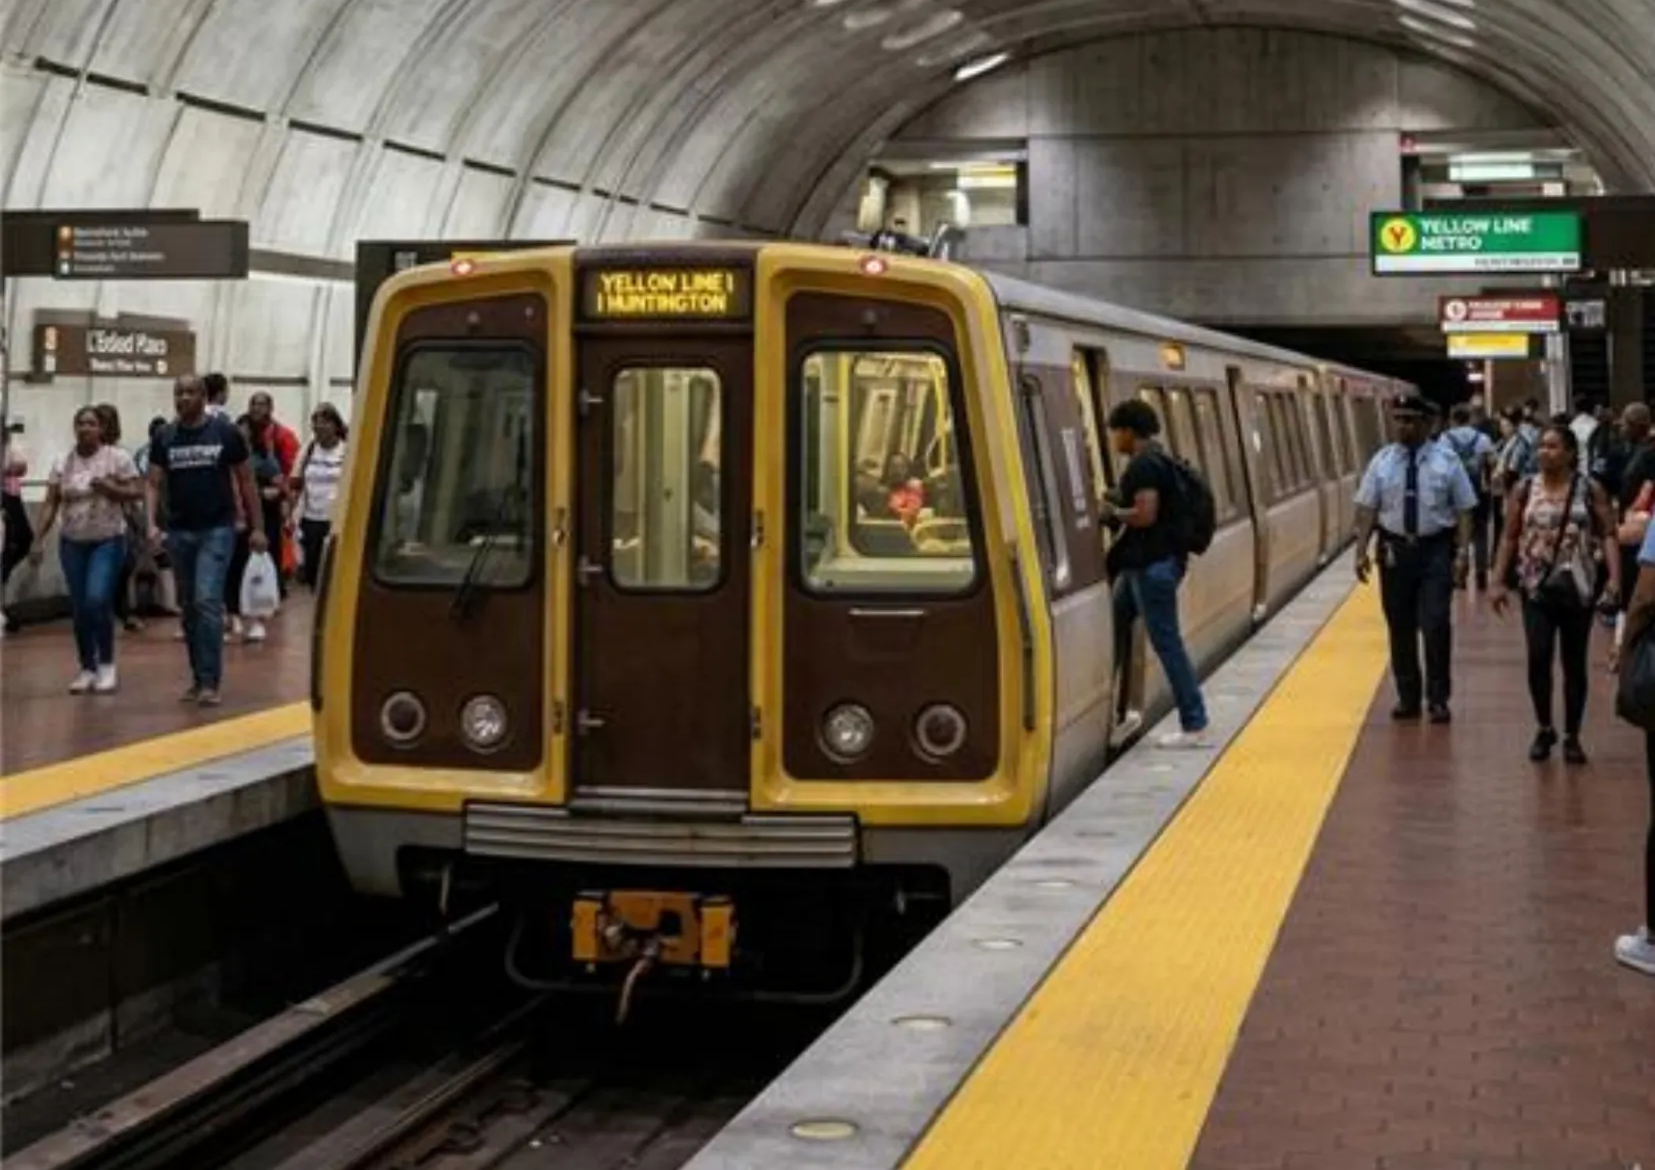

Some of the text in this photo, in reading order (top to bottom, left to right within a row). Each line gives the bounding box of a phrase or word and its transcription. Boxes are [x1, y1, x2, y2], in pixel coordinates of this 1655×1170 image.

[1420, 217, 1532, 234] YELLOW LINE
[1420, 235, 1483, 250] METRO
[600, 272, 677, 291] YELLOW
